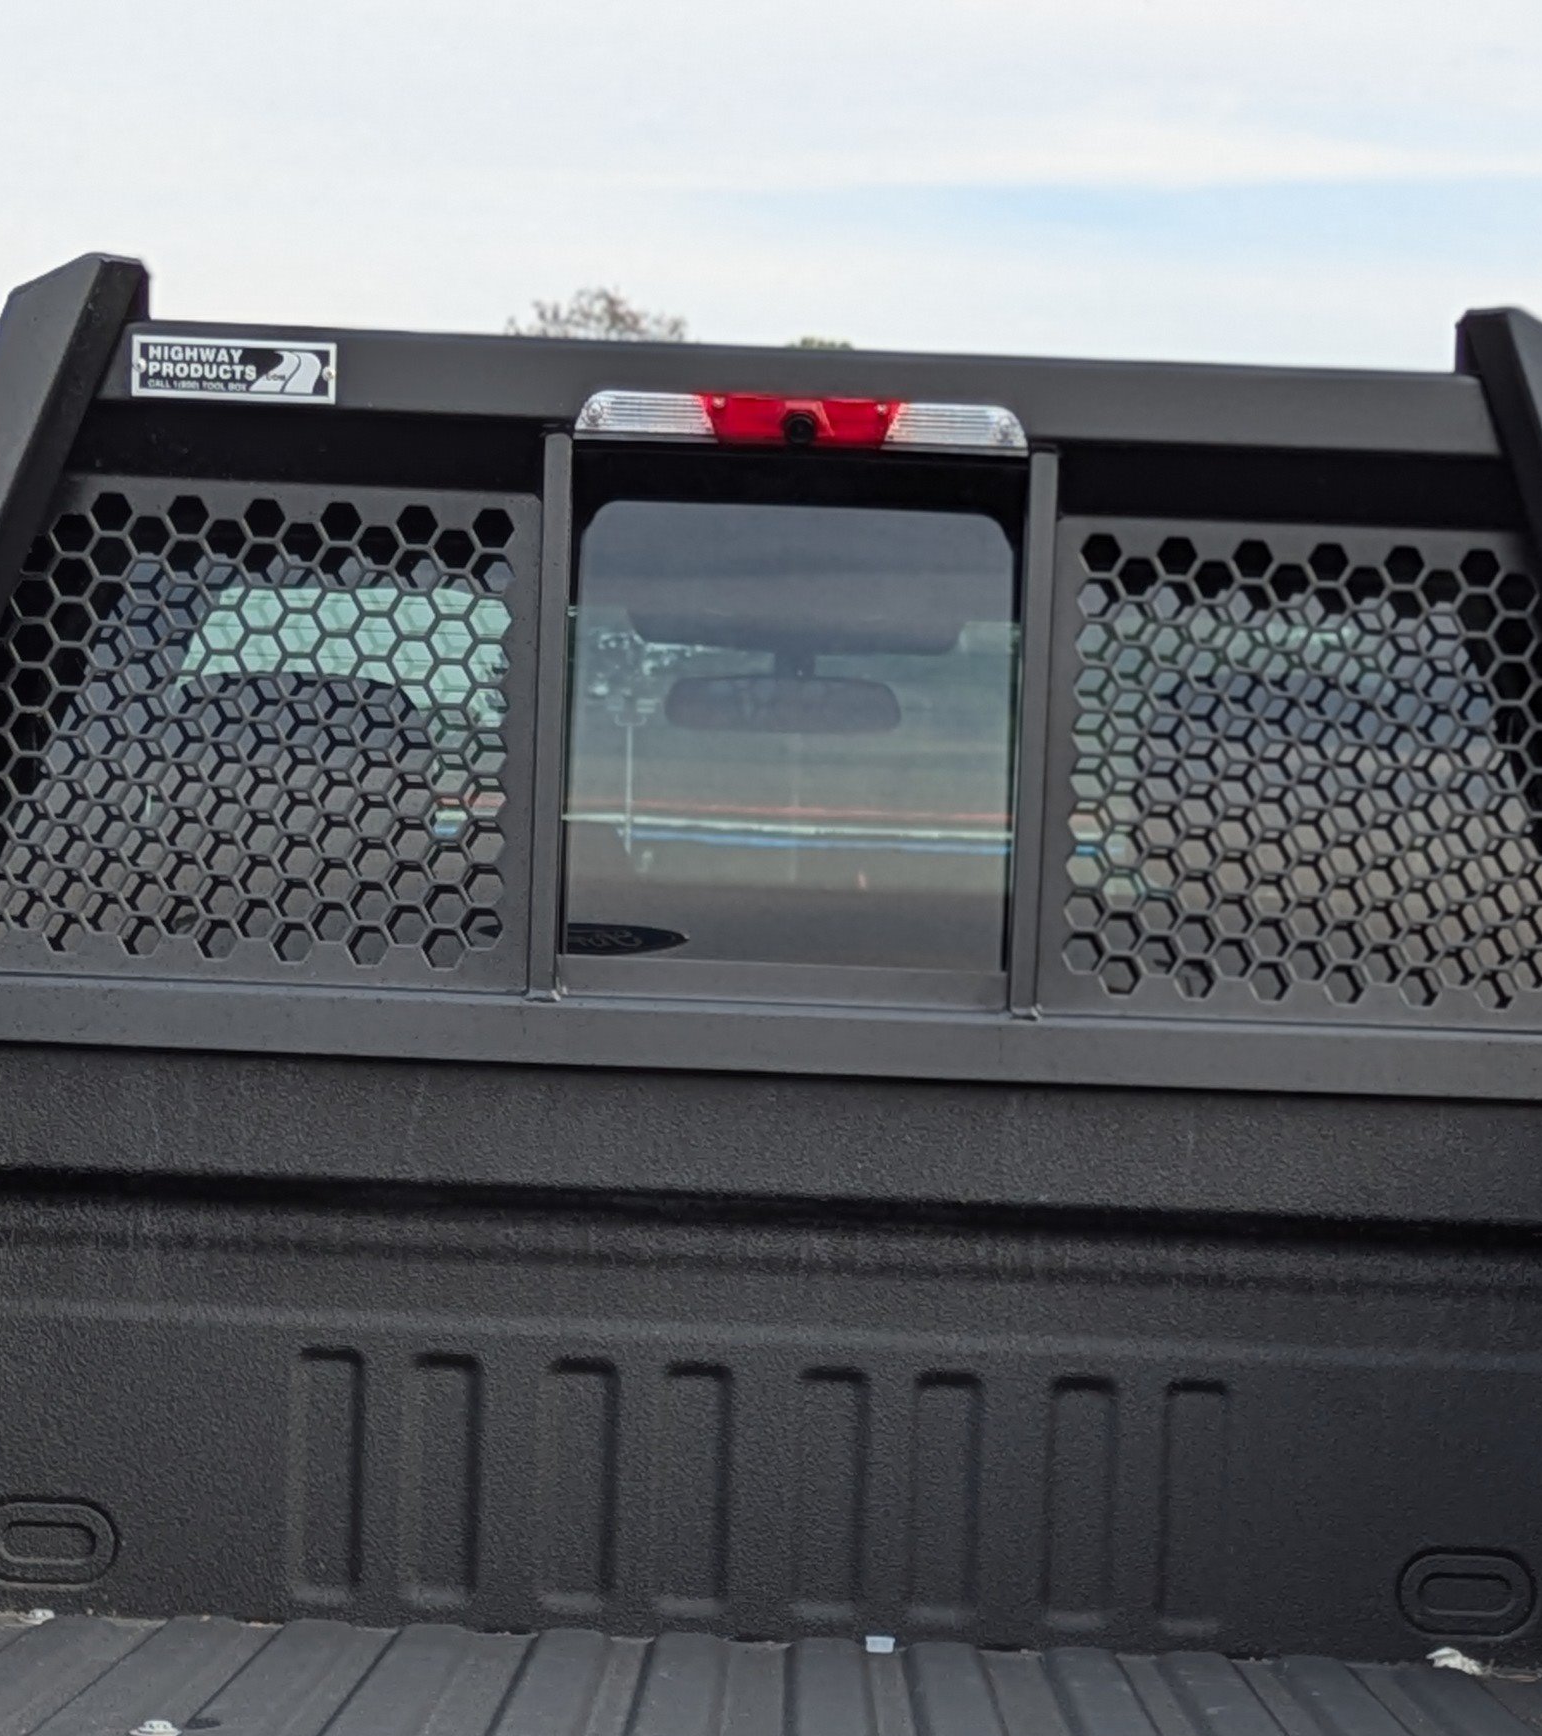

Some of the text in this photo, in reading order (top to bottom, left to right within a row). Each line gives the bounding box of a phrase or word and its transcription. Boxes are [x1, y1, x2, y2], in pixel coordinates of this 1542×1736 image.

[148, 345, 243, 364] HIGHWAY
[148, 363, 257, 380] PRODUCTS
[148, 378, 170, 388] CALL
[202, 381, 224, 391] TOOL
[227, 383, 247, 392] BOX
